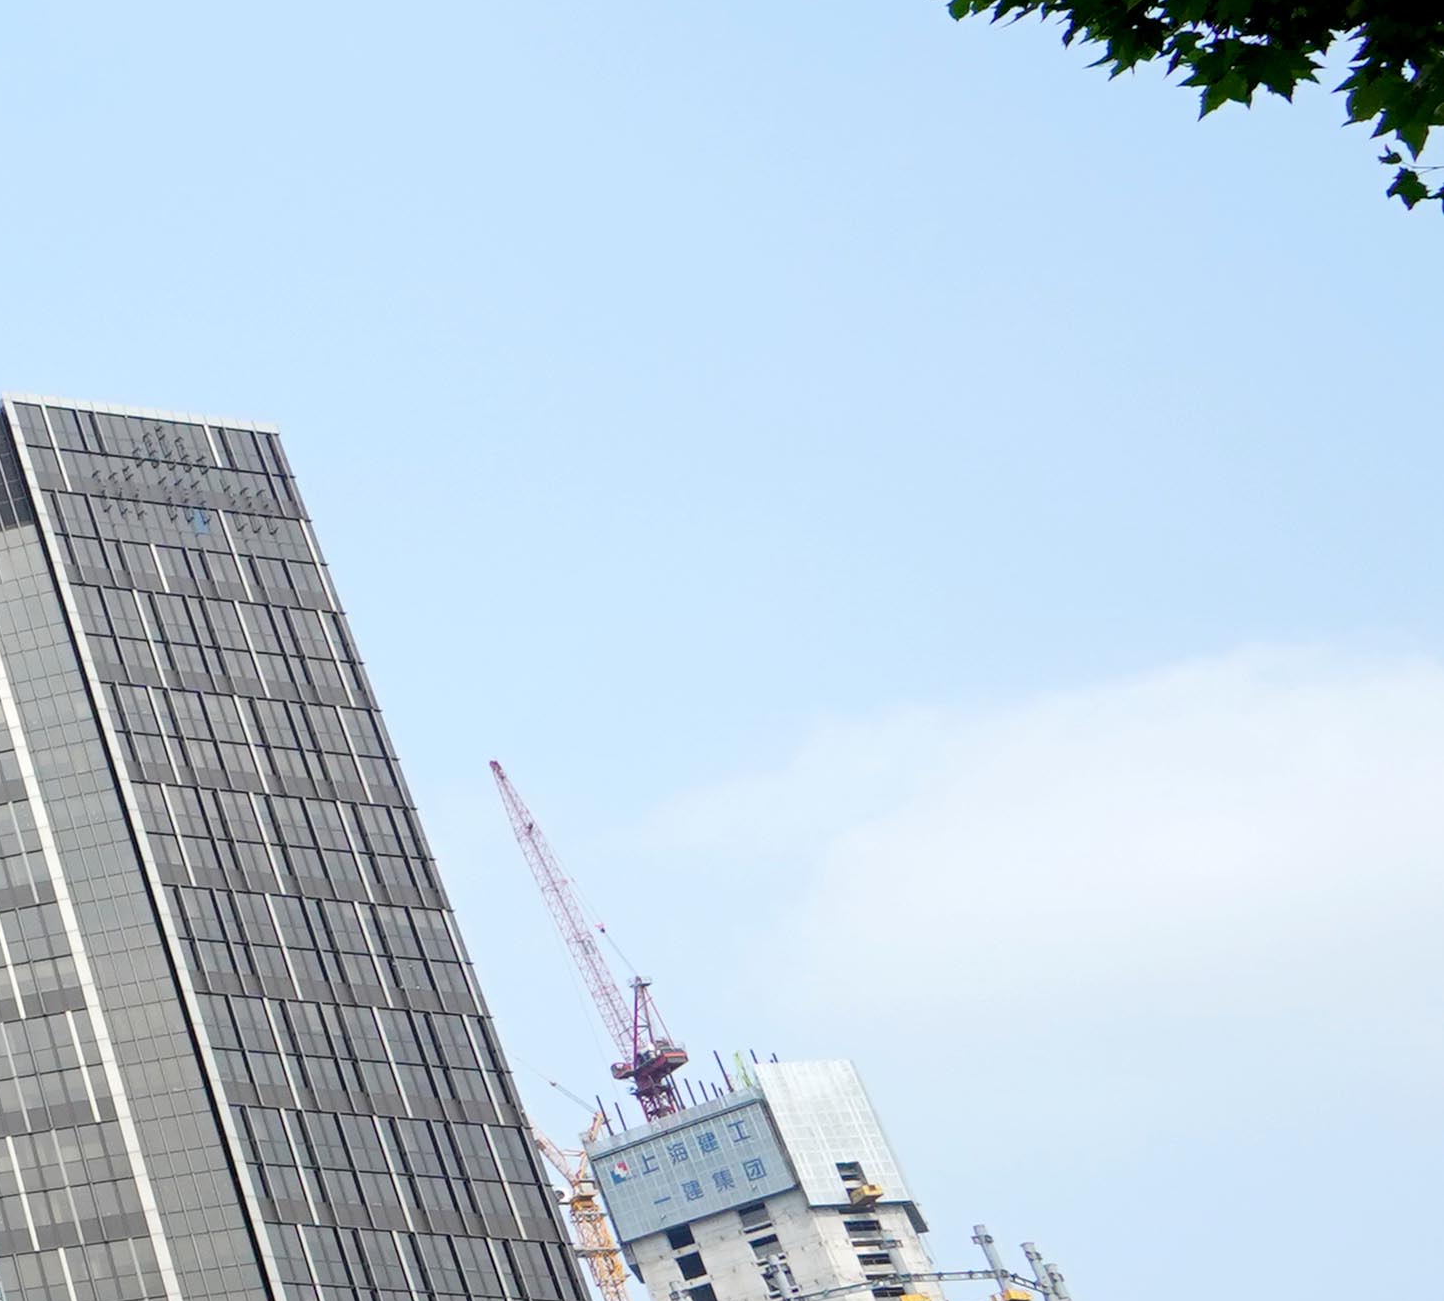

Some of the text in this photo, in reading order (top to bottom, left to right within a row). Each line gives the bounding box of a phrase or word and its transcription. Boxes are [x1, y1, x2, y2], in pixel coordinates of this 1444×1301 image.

[641, 1120, 751, 1175] 上海建工
[654, 1157, 767, 1204] 一建集团
